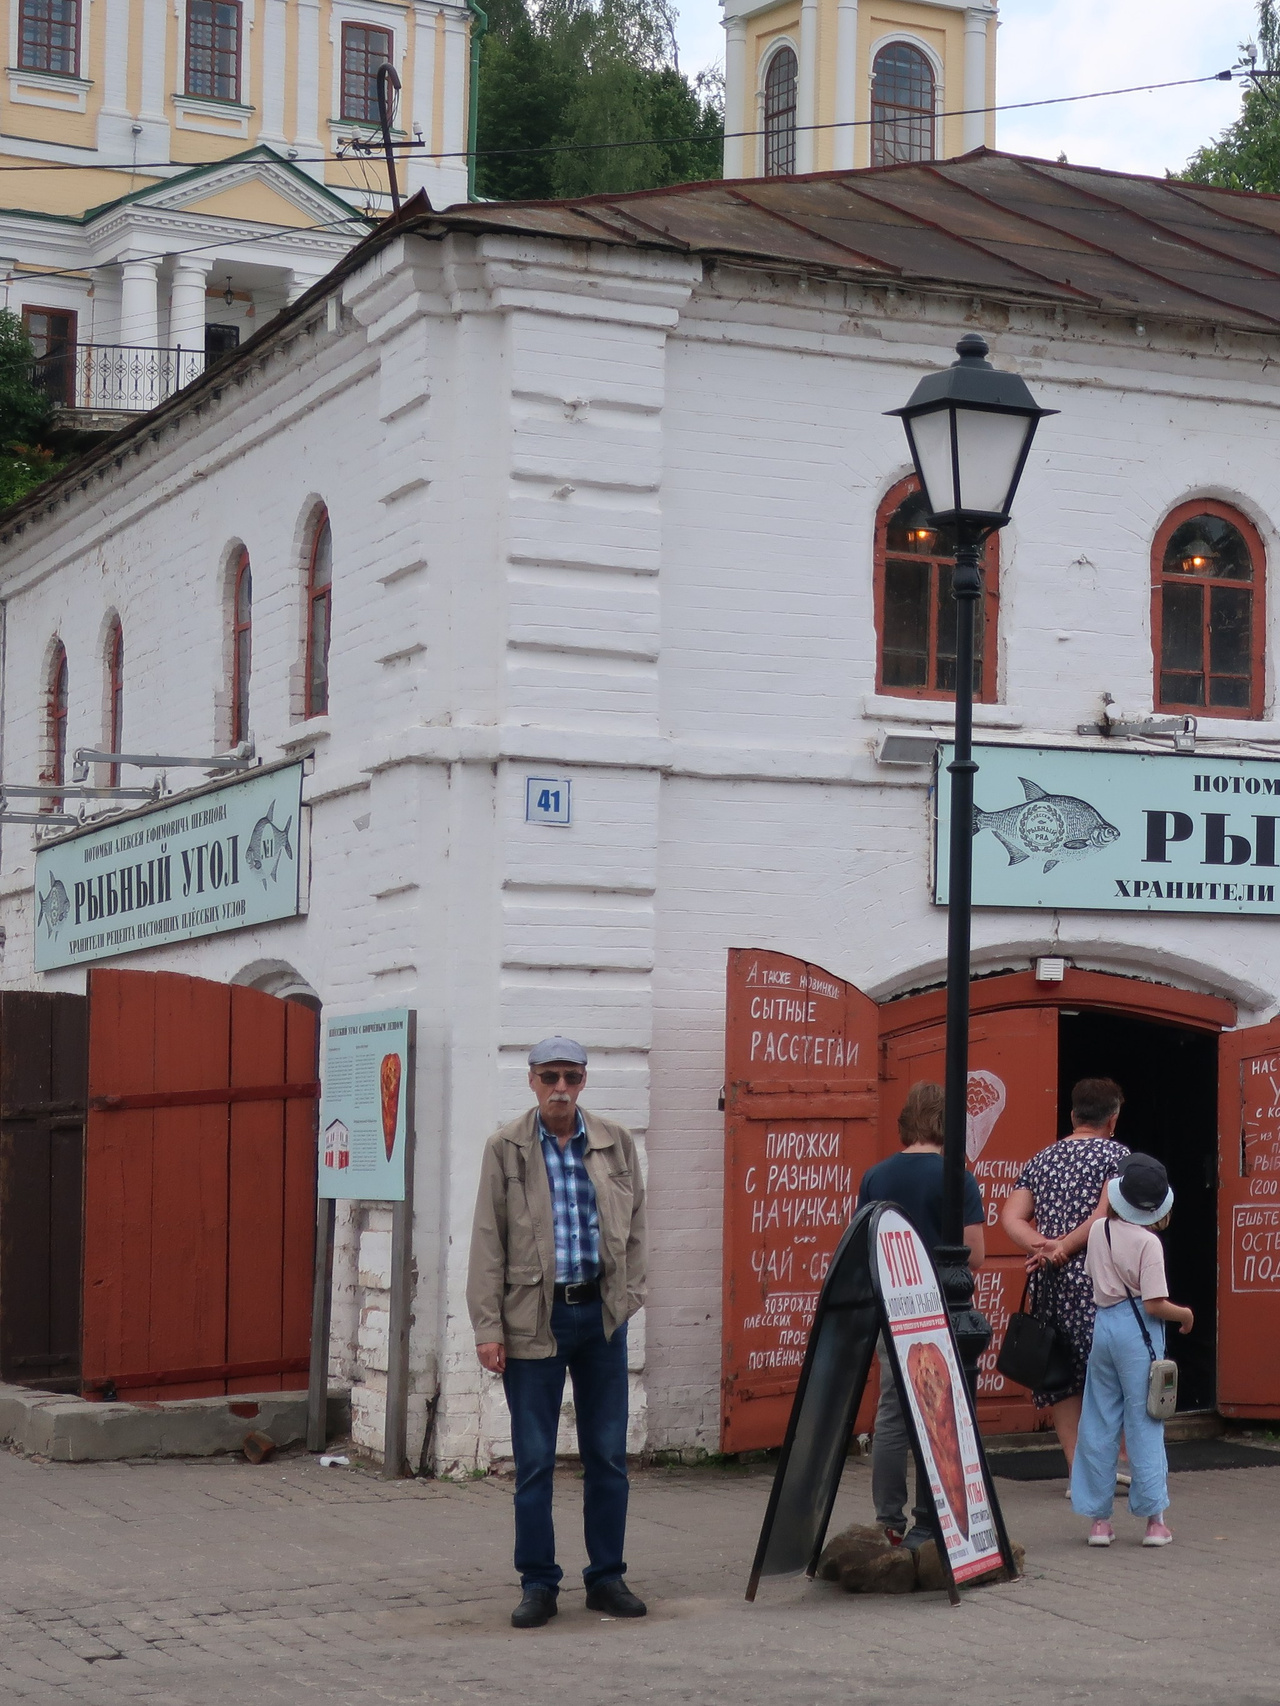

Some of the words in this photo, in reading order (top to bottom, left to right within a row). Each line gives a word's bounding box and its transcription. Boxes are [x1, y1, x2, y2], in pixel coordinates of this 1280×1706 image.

[537, 789, 560, 813] 41
[84, 841, 113, 863] ПОТОМКИ
[115, 830, 144, 853] АЛЕКСЕЯ
[146, 816, 189, 843] ЕФИМОВИЧА
[191, 803, 227, 829] ШЕВЦОВА
[74, 842, 172, 925] РЫБНЫЙ
[181, 834, 239, 897] УГОЛ
[1114, 879, 1274, 903] ХРАНИТЕЛИ
[69, 935, 105, 955] ХРАНИТЕЛИ
[106, 926, 136, 947] РЕЦЕПТА
[138, 916, 179, 938] НАСТОЯЩИХ
[181, 907, 220, 929] ПЛЁССКИХ
[221, 899, 246, 920] УГЛОВ
[746, 961, 758, 983] А
[762, 970, 791, 985] ТАКЖЕ
[751, 997, 817, 1023] СЫТНЫЕ
[750, 1031, 859, 1067] РАССТЕГАИ
[766, 1132, 840, 1160] ПИРОЖКИ
[745, 1167, 756, 1194] С
[767, 1164, 851, 1194] РАЗНЫМИ
[1237, 1211, 1280, 1227] ЕШЬТЕ
[751, 1246, 793, 1283] ЧАЙ
[879, 1230, 923, 1288] УГОЛ
[743, 1314, 792, 1330] ПЛЁССКИХ
